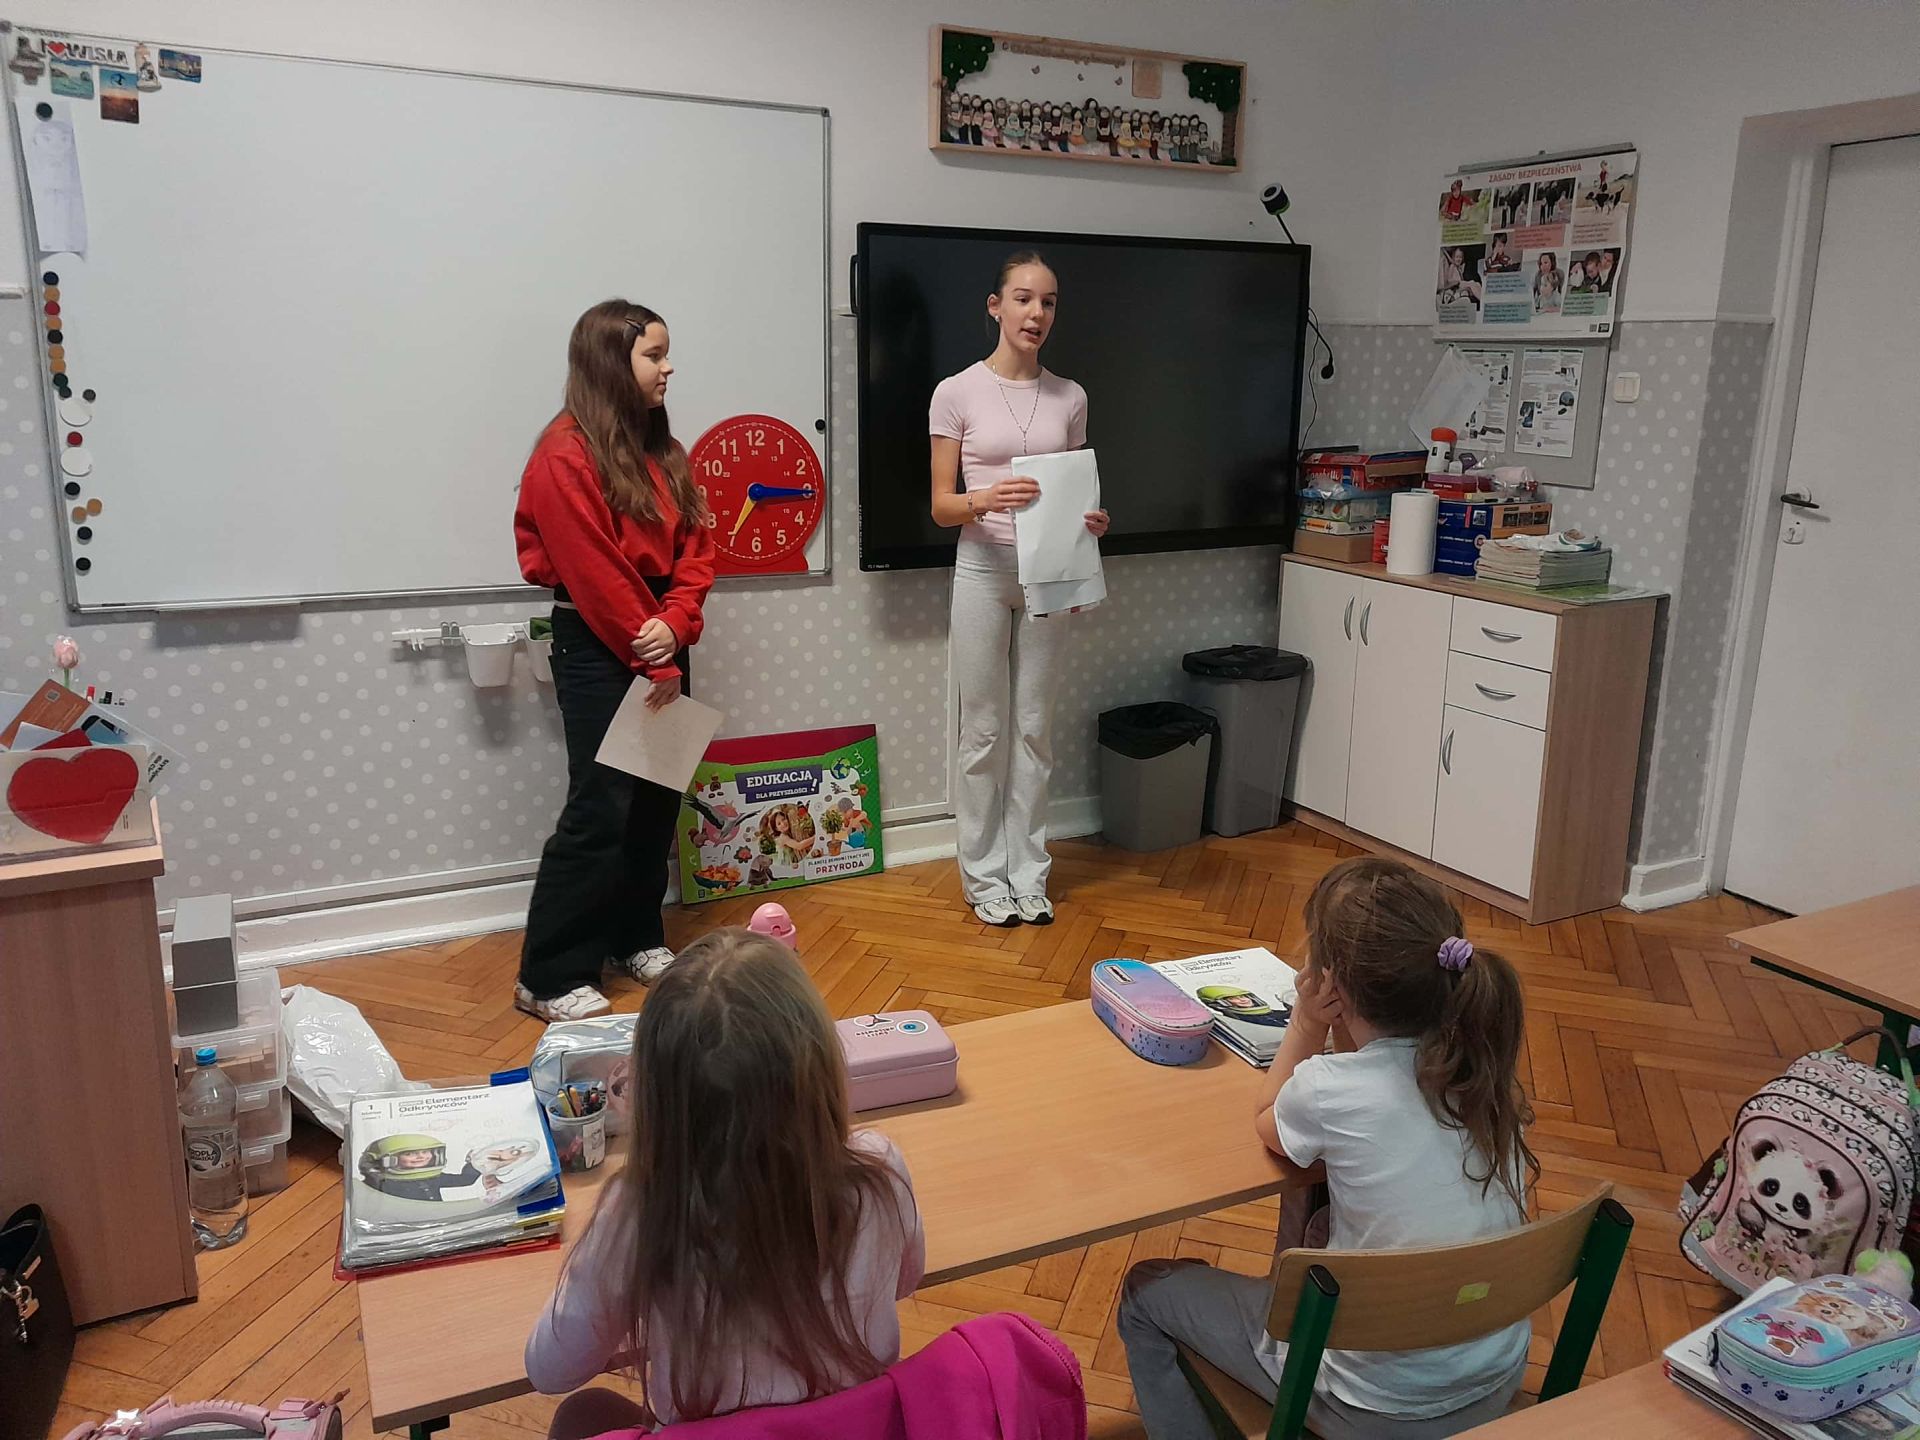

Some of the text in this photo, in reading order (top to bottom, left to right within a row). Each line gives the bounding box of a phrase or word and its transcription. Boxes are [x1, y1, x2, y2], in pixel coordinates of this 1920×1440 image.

[1489, 172, 1516, 183] ZASADY
[745, 429, 765, 447] 12
[777, 438, 784, 455] 1
[719, 438, 737, 456] 11
[751, 449, 759, 457] 24
[702, 459, 723, 477] 10
[796, 458, 806, 475] 2
[794, 510, 805, 526] 4
[752, 536, 762, 553] 6
[776, 529, 787, 546] 5
[746, 770, 813, 788] EDUKACJA
[815, 860, 865, 875] PRZYRODA
[398, 1101, 468, 1113] Odkrywców
[425, 1092, 491, 1105] Elementarz
